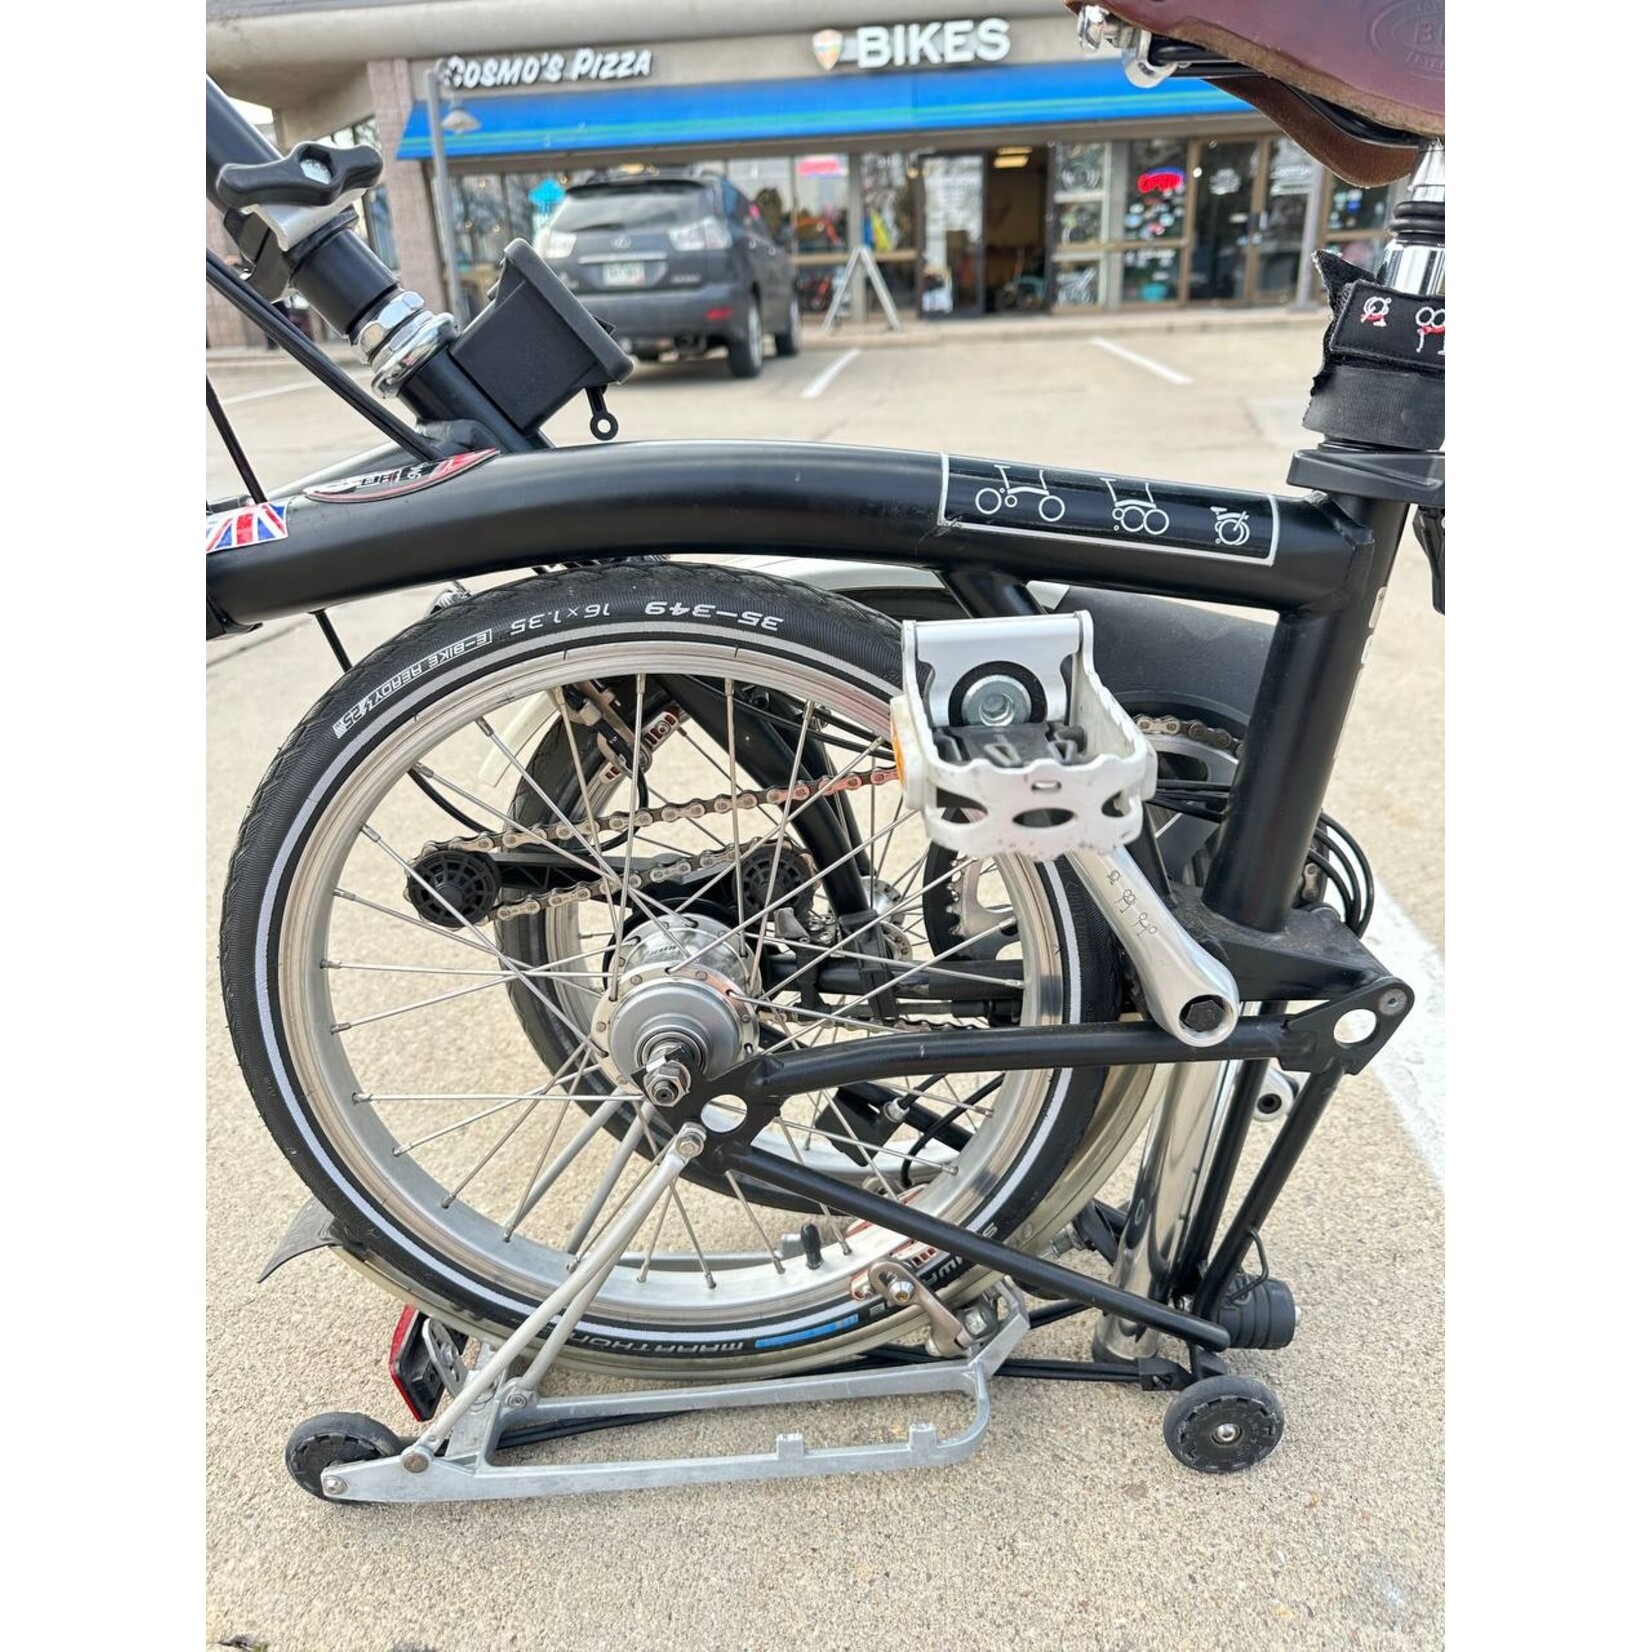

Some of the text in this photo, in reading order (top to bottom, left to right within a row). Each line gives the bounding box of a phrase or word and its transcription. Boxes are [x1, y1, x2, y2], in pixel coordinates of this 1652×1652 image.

[857, 17, 1011, 69] BIKES
[571, 47, 652, 81] PIZZA
[644, 601, 784, 632] 35-349
[428, 632, 488, 665] E-BIKE
[374, 664, 423, 699] READY
